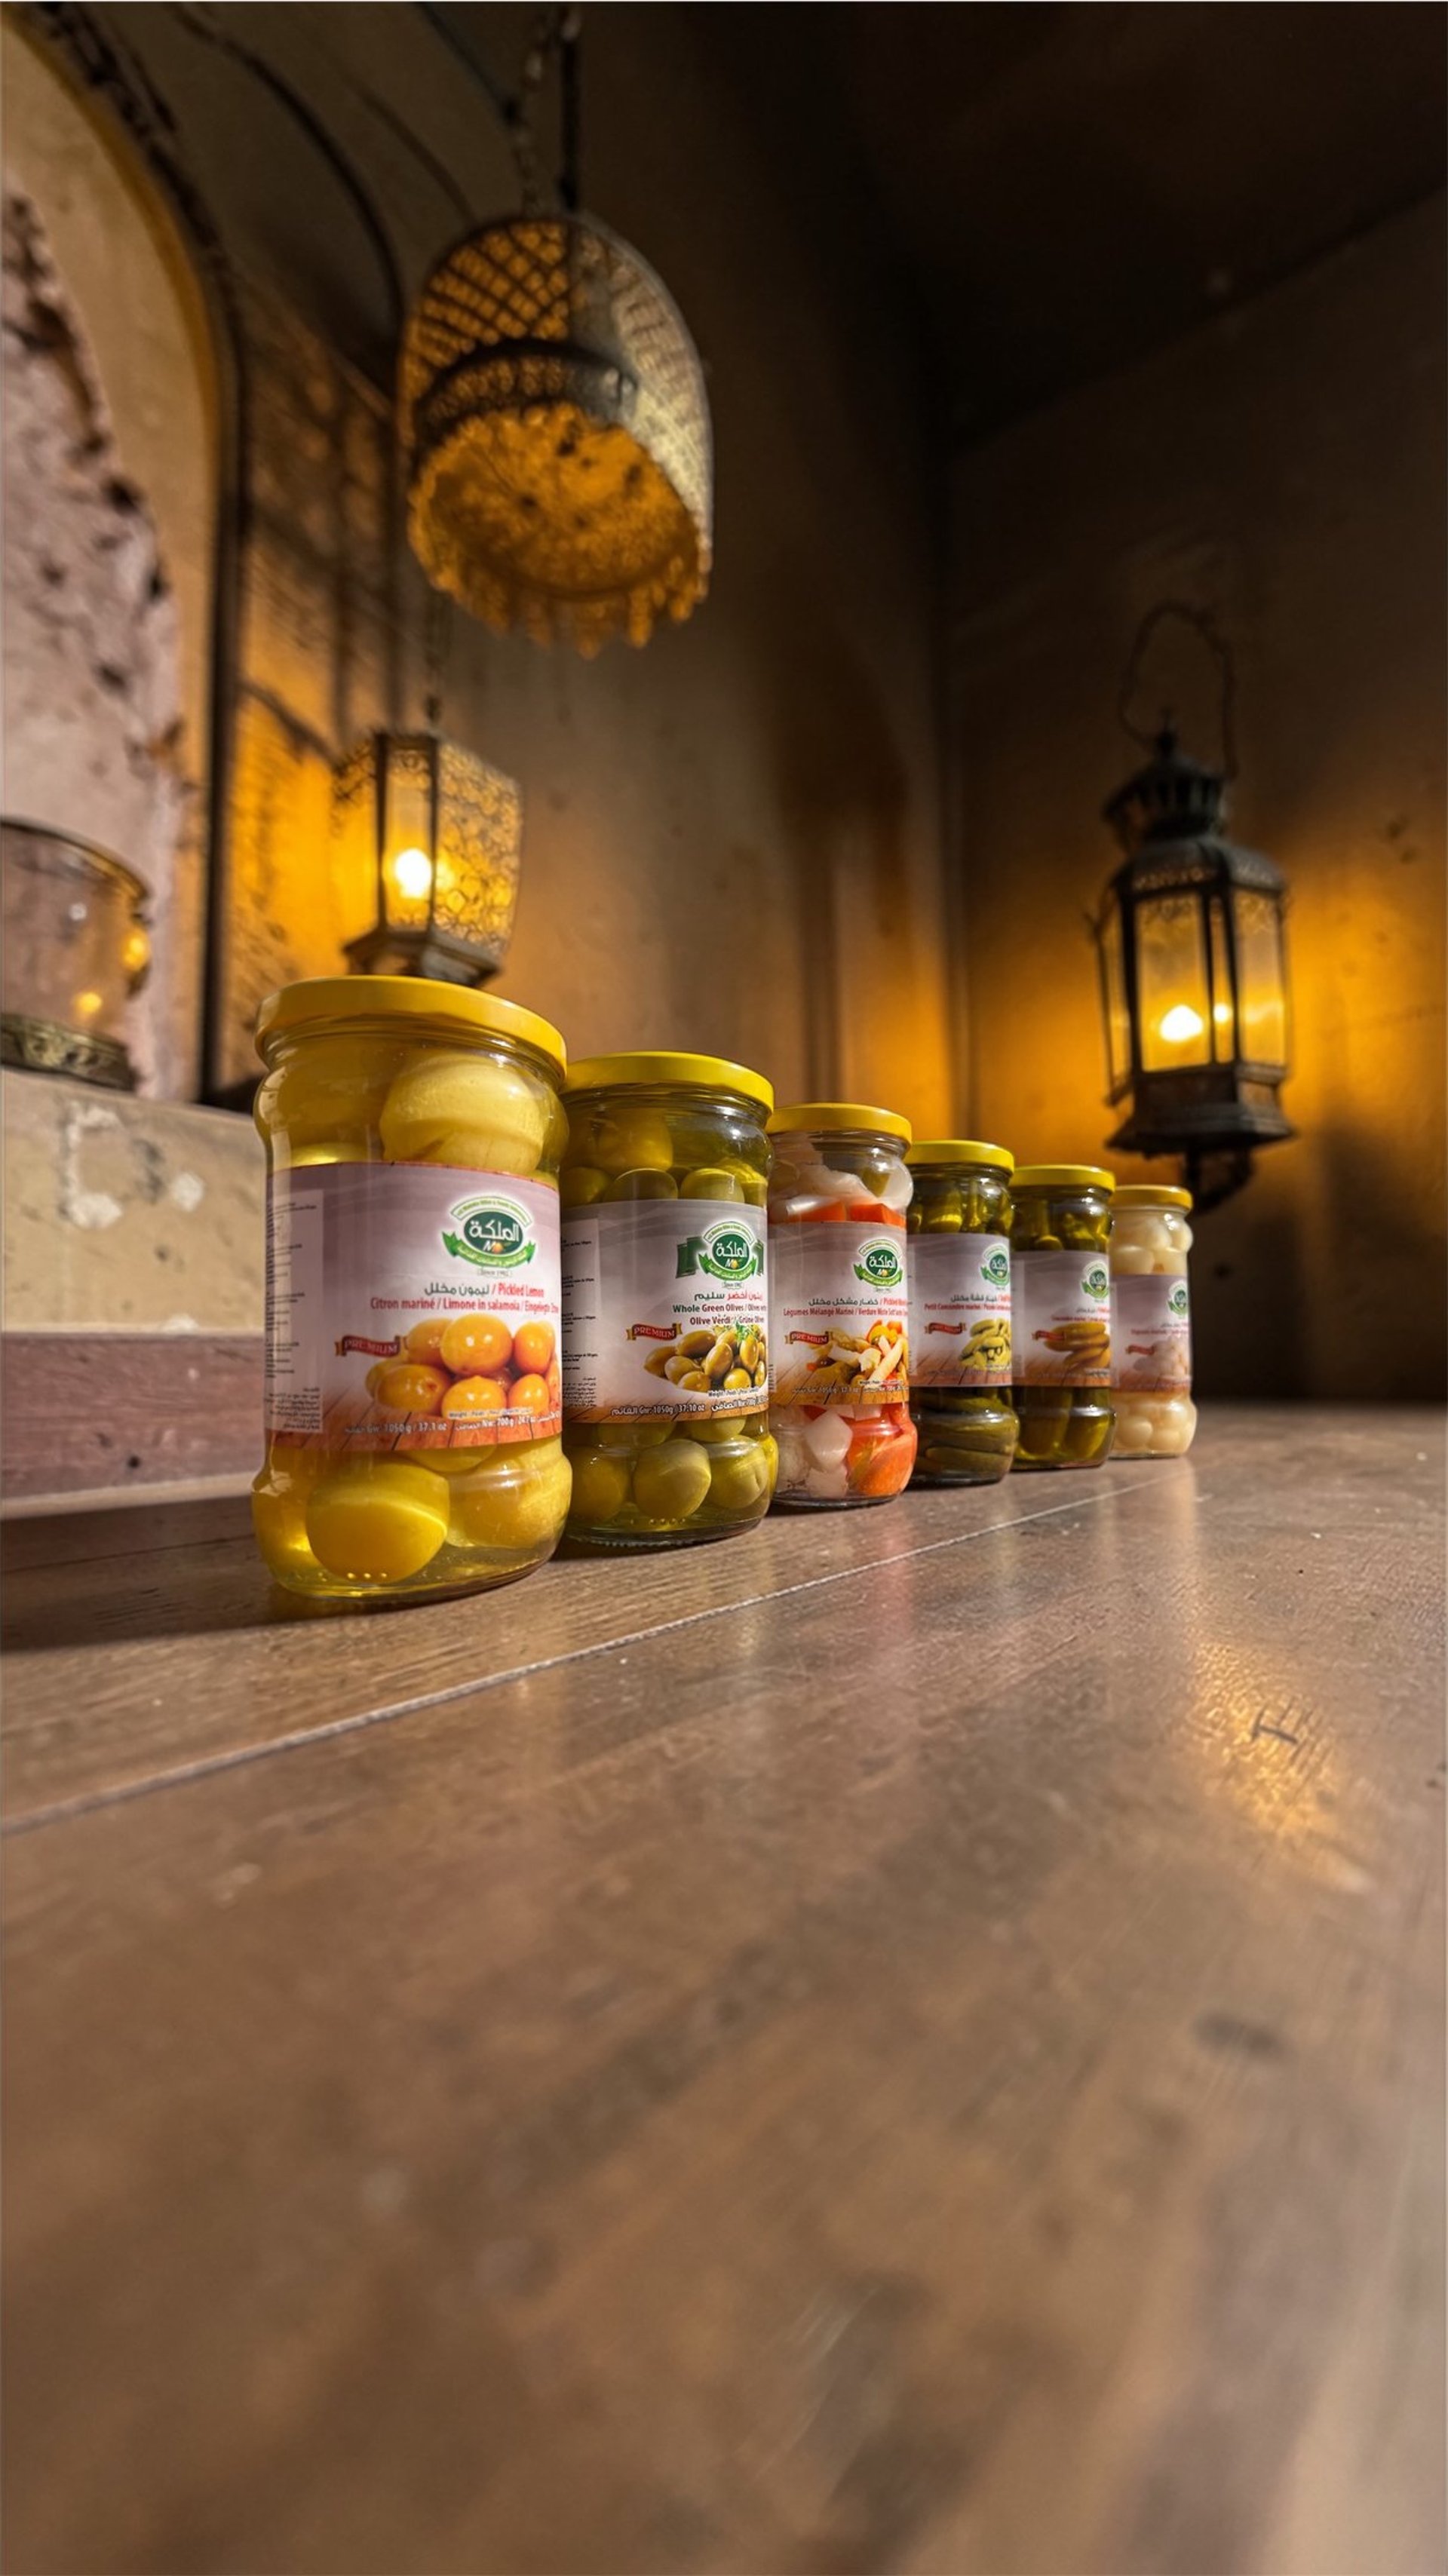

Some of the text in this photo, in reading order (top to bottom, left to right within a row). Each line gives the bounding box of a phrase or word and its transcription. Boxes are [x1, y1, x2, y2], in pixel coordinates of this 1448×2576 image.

[469, 1219, 520, 1241] الملكة
[716, 1241, 748, 1258] الملكة
[870, 1255, 897, 1269] الملكة
[424, 1282, 457, 1296] مخلل
[458, 1283, 490, 1296] ليمون
[498, 1283, 524, 1296] Pickled
[370, 1297, 399, 1309] Citron
[400, 1296, 435, 1309] mariné
[443, 1297, 475, 1310] Limone
[694, 1292, 724, 1302] سليم
[808, 1298, 831, 1306] مخلل
[833, 1297, 858, 1306] مشكل
[673, 1305, 700, 1313] Whole
[701, 1304, 724, 1312] Green
[726, 1304, 744, 1312] Olives
[784, 1308, 809, 1317] Légumes
[690, 1316, 710, 1325] Olive
[634, 1326, 675, 1339] PREMIUM
[791, 1333, 827, 1343] PREMIUM
